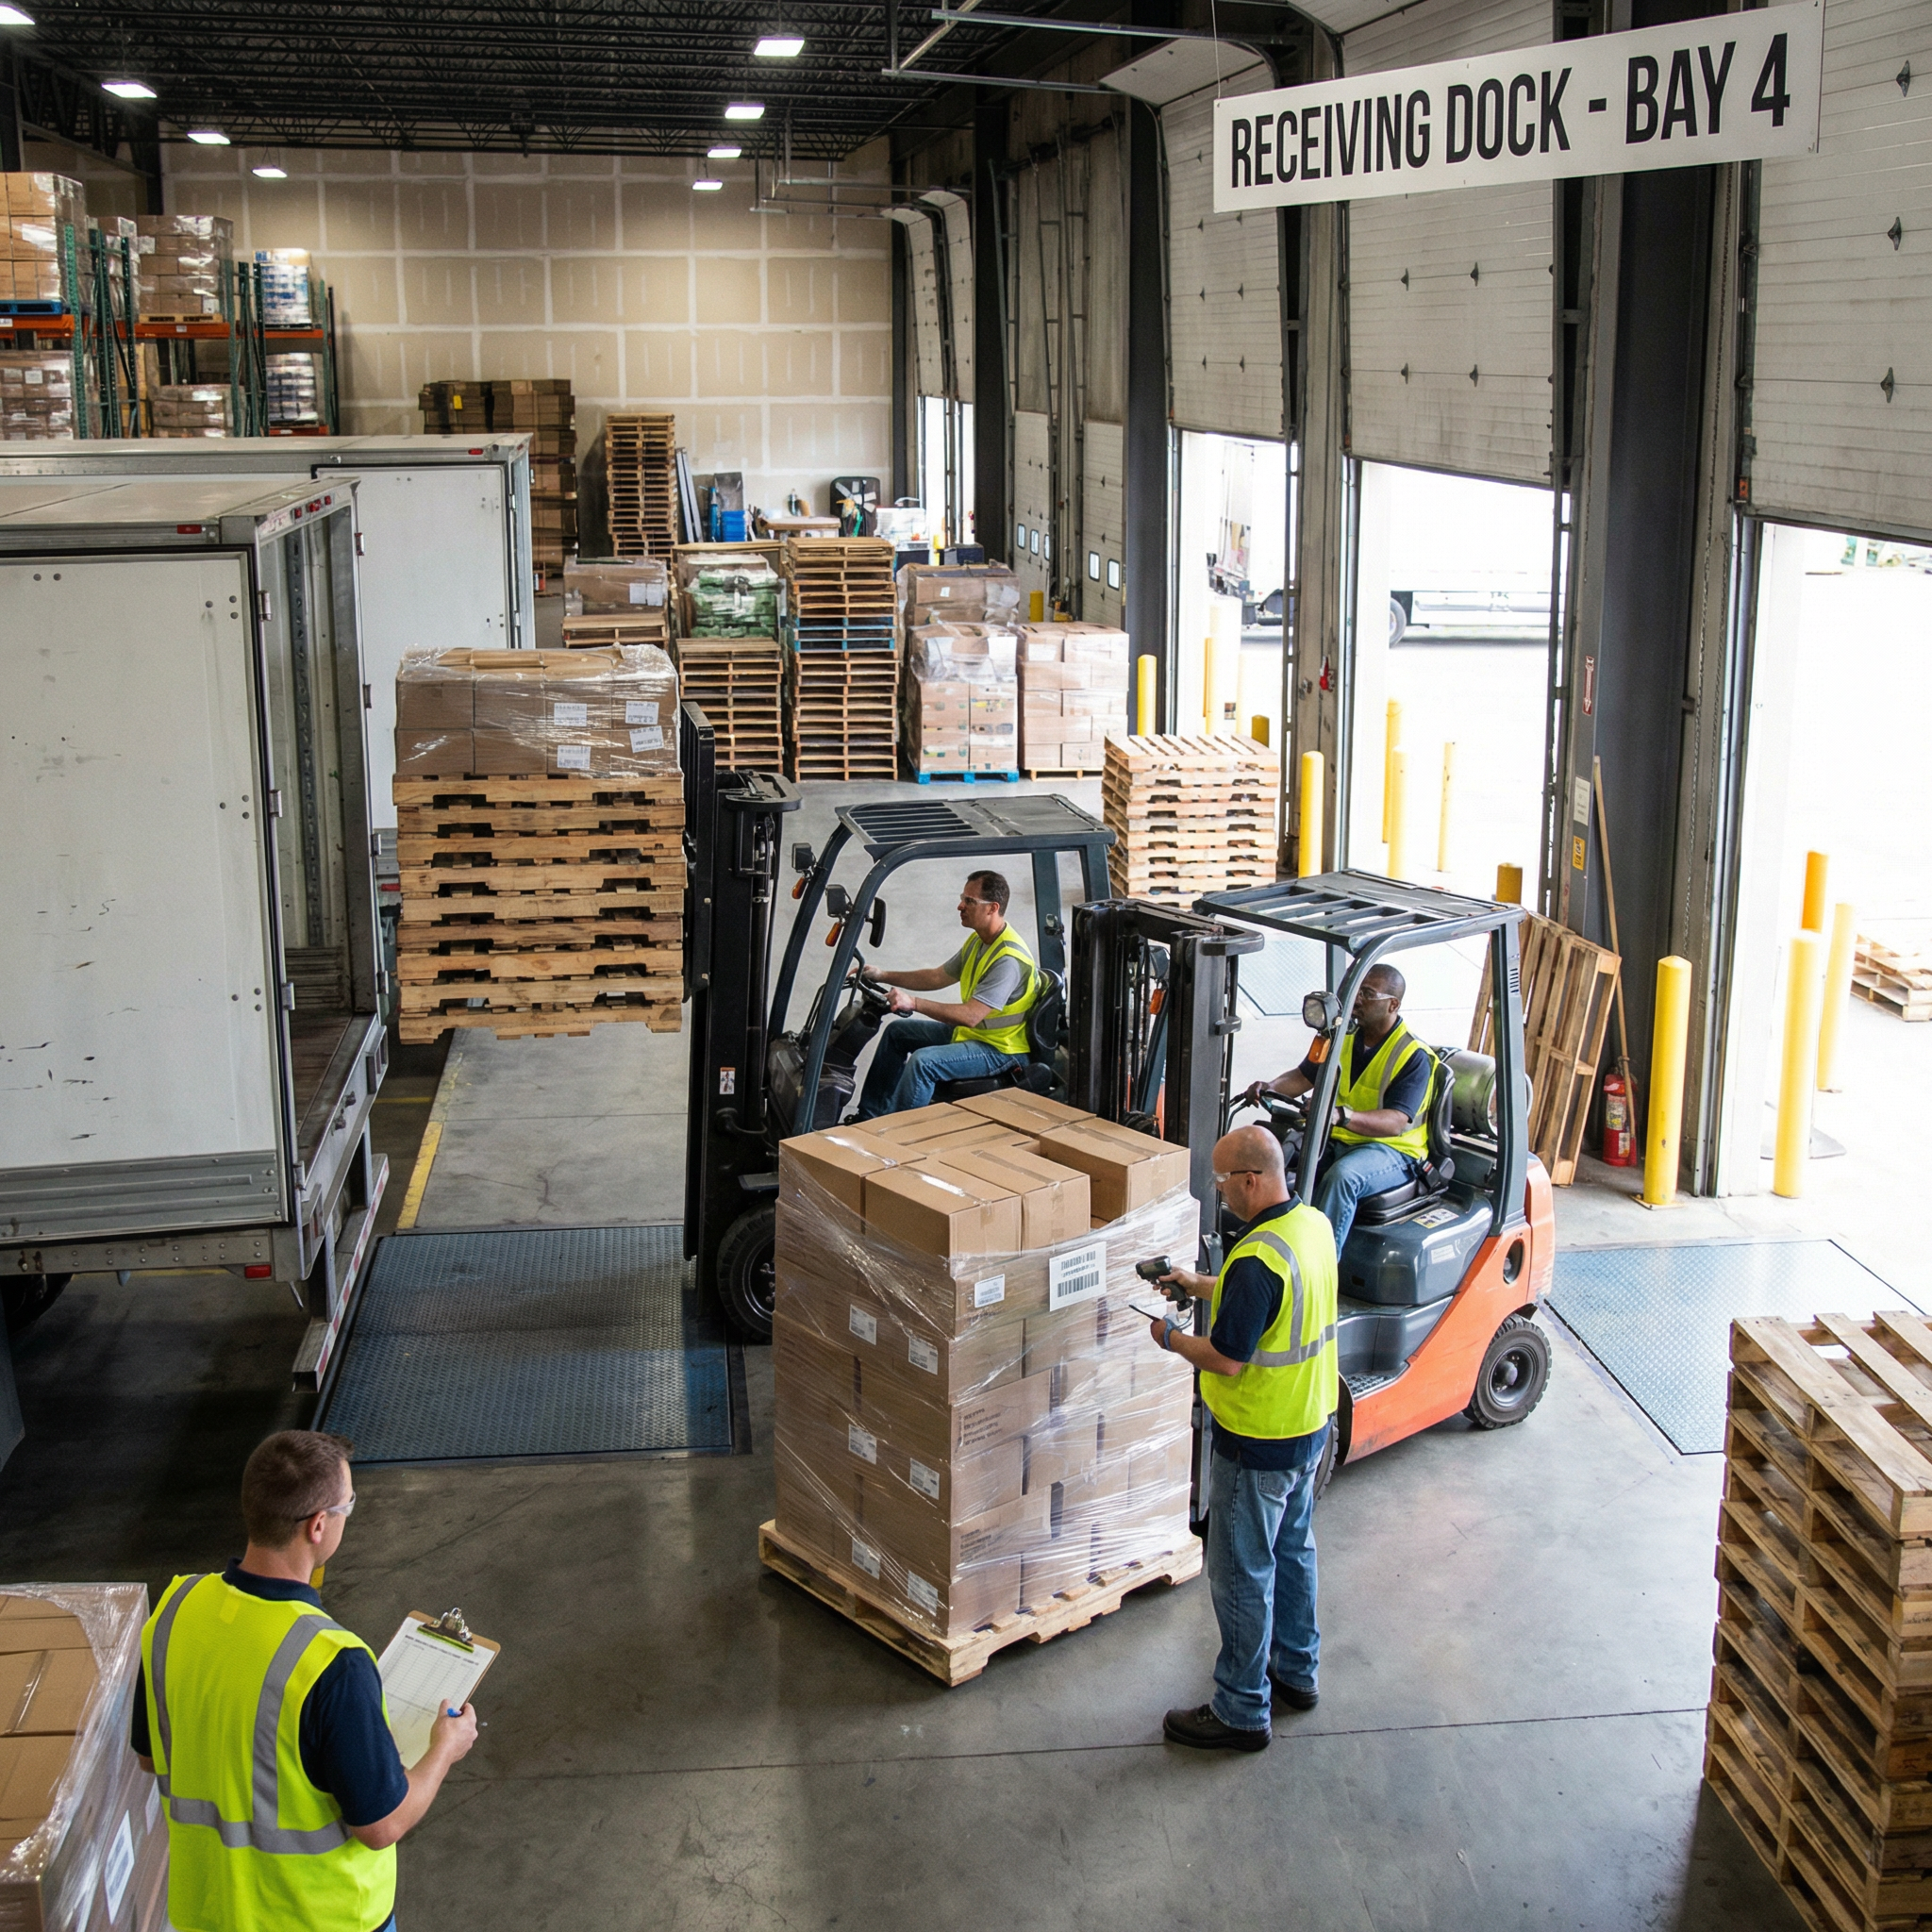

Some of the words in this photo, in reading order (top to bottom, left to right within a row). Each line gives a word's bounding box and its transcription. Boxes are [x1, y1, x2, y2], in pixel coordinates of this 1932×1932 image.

[1232, 90, 1431, 189] RECEIVING
[1445, 67, 1573, 164] DOCK
[1589, 97, 1607, 113] -
[1625, 41, 1737, 145] BAY
[1750, 33, 1791, 127] 4
